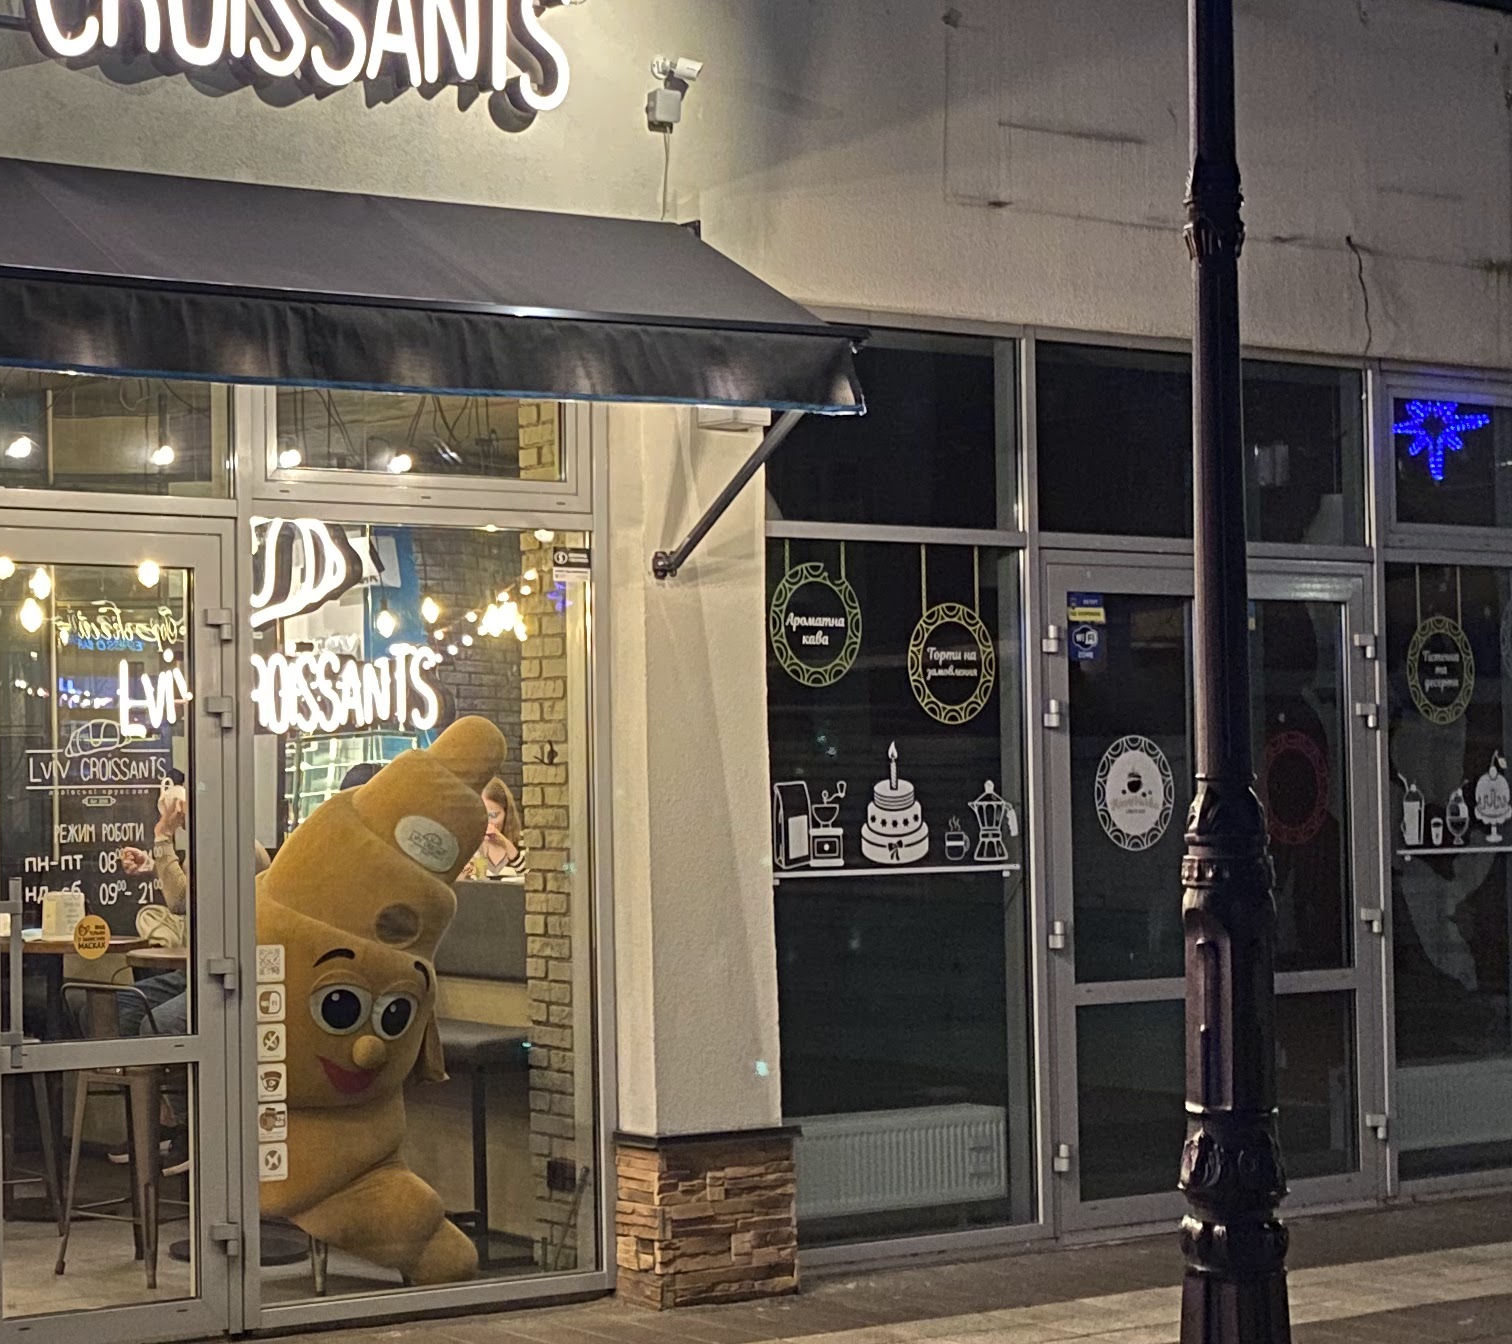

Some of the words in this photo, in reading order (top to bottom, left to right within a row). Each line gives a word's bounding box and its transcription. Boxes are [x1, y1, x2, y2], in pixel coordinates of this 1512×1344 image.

[785, 613, 845, 631] Ароматна
[802, 630, 829, 645] кава
[927, 647, 961, 665] Торти
[963, 650, 977, 661] на
[927, 667, 978, 680] замовлення
[55, 823, 95, 843] РЕЖИМ
[101, 822, 145, 843] РОБОТИ
